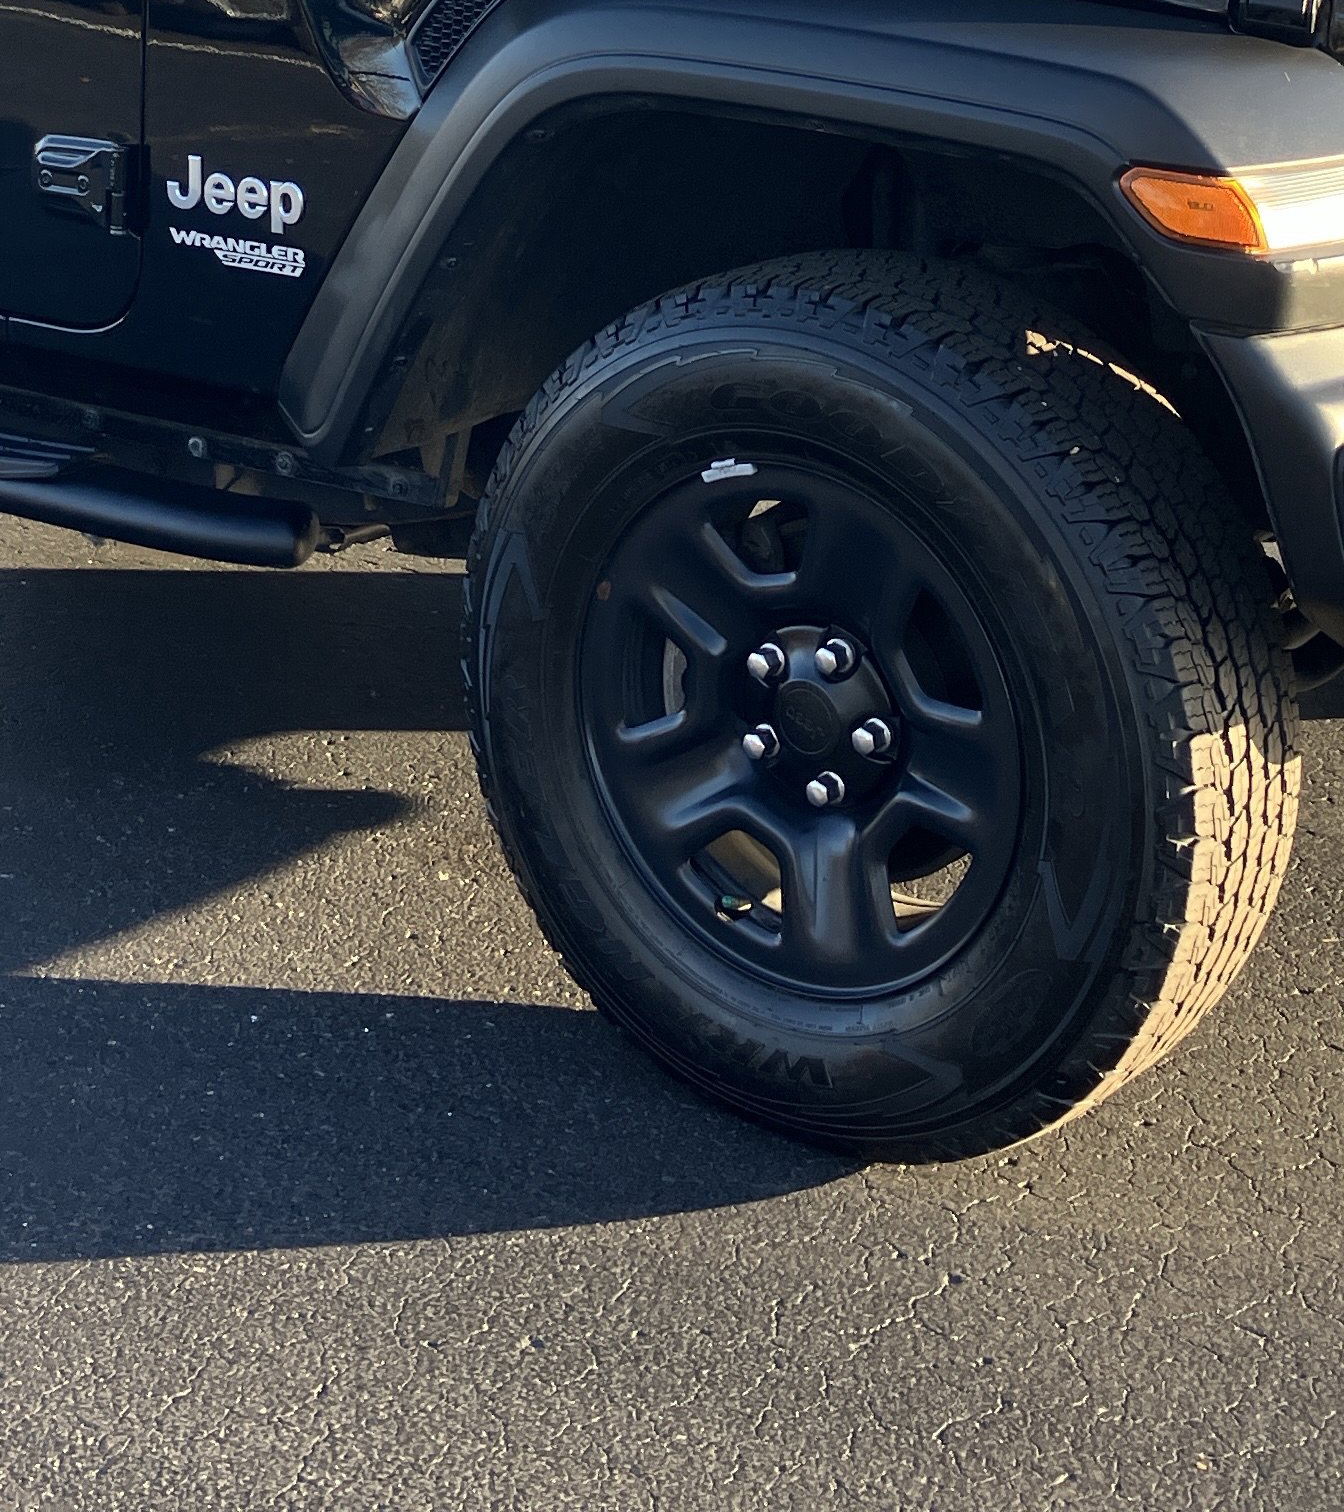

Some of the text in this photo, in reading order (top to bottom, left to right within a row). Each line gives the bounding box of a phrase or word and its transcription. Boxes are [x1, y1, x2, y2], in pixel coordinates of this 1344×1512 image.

[166, 154, 304, 234] Jeep
[169, 226, 306, 263] WRANGLER
[221, 253, 304, 275] SPORT
